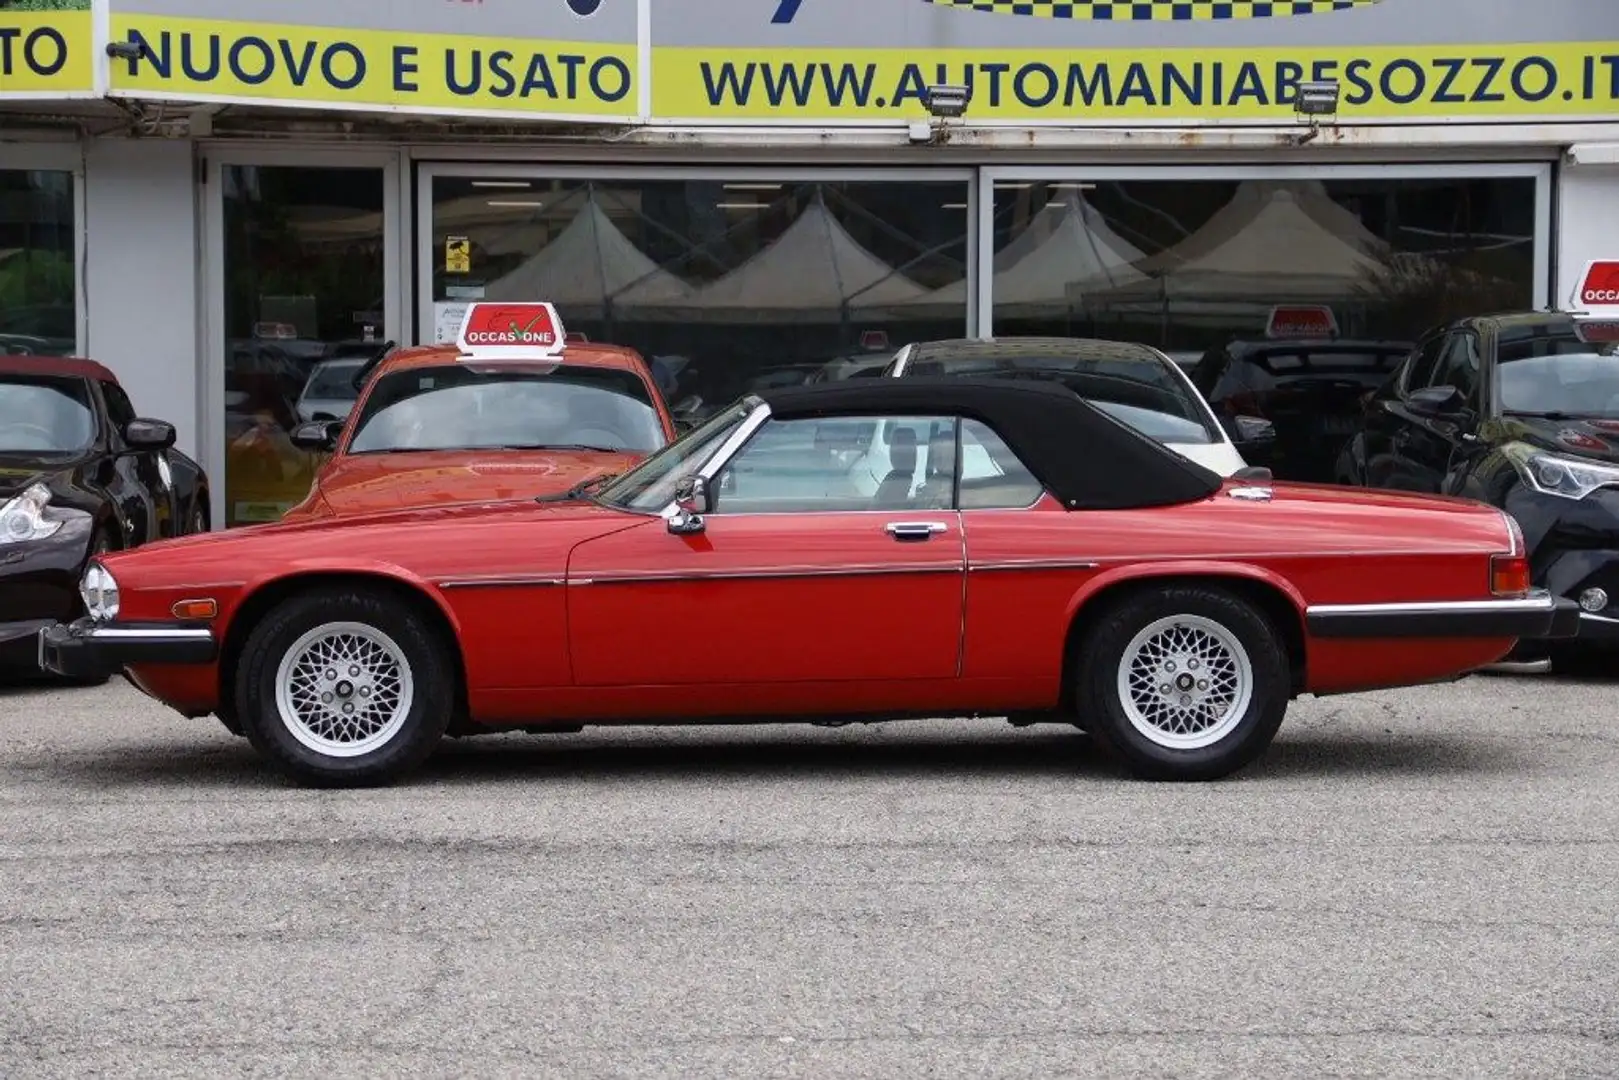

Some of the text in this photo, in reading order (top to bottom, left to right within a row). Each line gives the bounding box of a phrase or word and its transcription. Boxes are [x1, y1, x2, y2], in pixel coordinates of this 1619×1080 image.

[0, 27, 67, 76] TO
[127, 29, 631, 103] NUOVO E USATO
